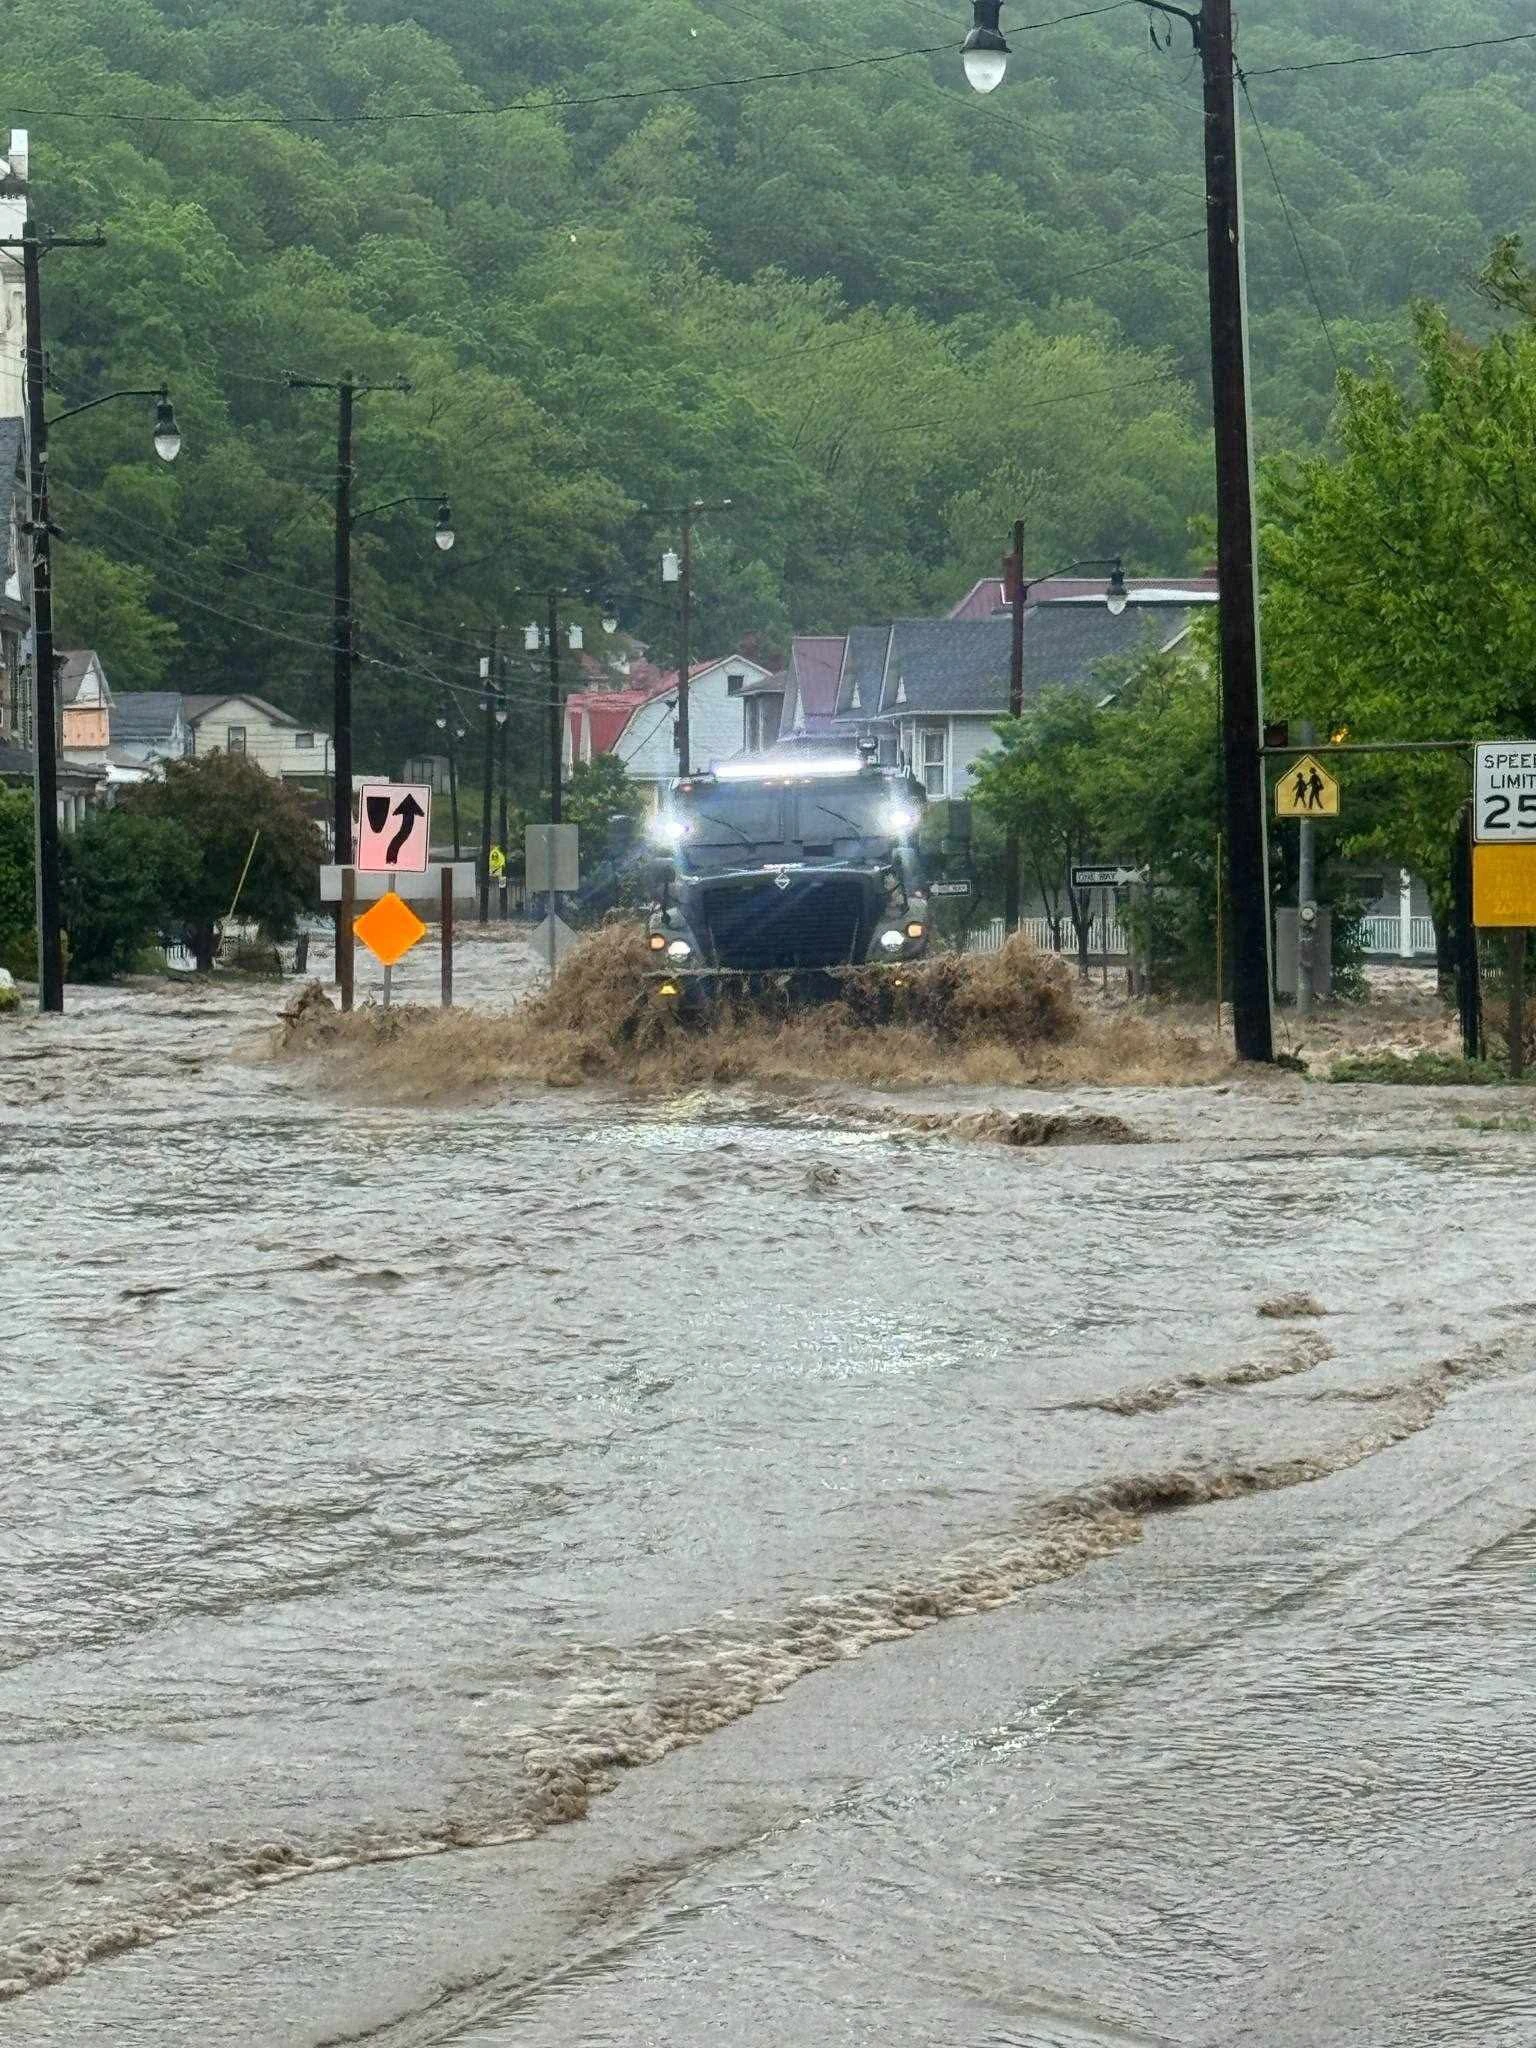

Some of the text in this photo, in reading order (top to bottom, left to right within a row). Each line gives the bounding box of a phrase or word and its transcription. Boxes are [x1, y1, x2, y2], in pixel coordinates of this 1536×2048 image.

[1484, 753, 1536, 769] SPEE
[1490, 773, 1536, 789] LIMIT
[1483, 794, 1536, 829] 25
